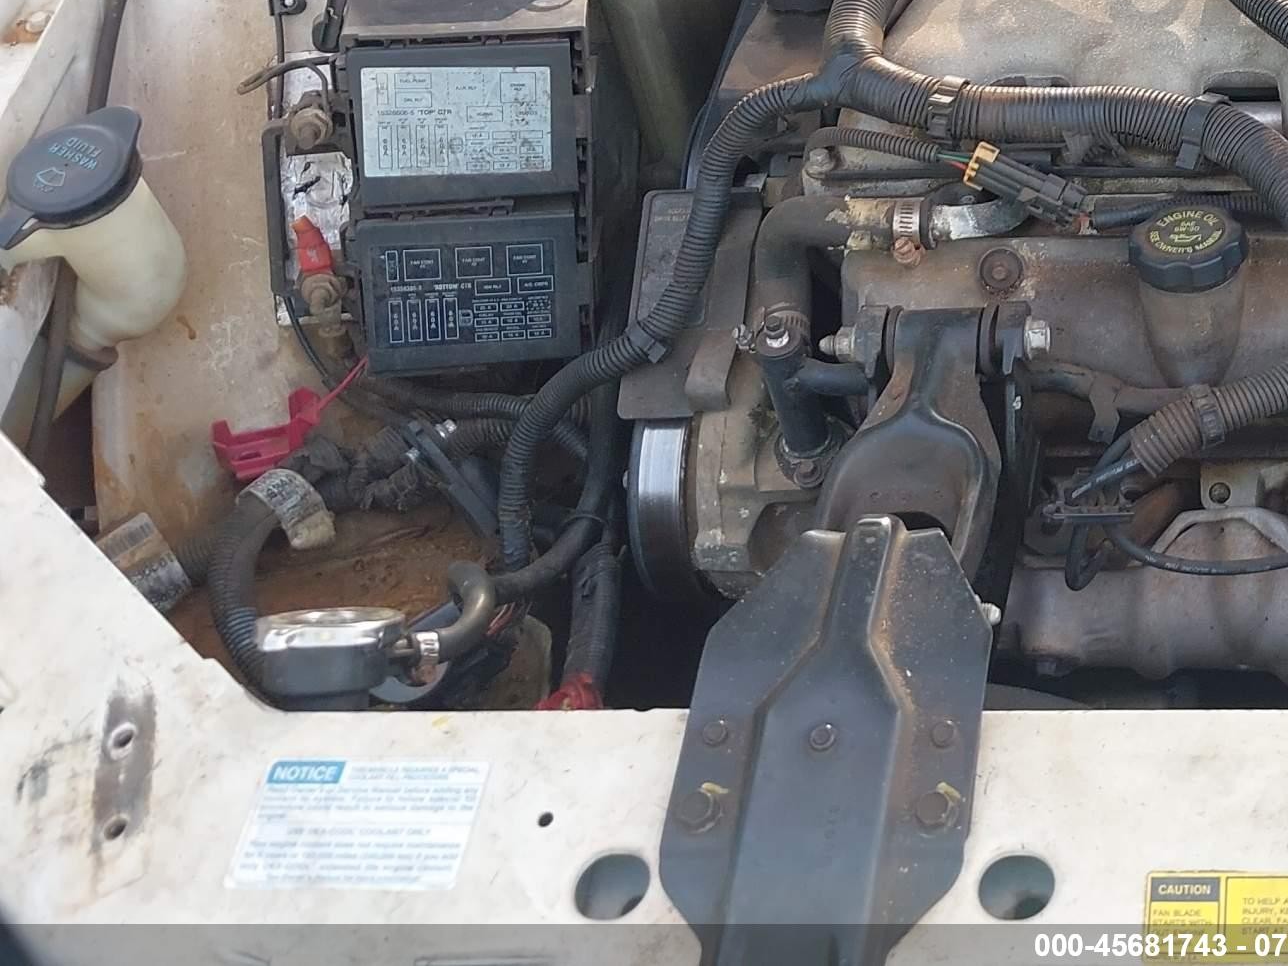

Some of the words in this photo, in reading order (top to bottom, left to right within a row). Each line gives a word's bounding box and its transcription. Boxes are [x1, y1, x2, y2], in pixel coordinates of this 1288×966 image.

[65, 137, 103, 158] FLUID
[47, 142, 97, 171] WASHER
[1156, 211, 1204, 227] ENGINE
[1203, 213, 1220, 227] OIL
[272, 765, 338, 781] NOTICE
[1158, 884, 1212, 895] CAUTION
[1242, 897, 1254, 905] TO
[1257, 897, 1281, 905] HELP
[1153, 909, 1170, 917] FAN
[1173, 909, 1202, 917] BLADE
